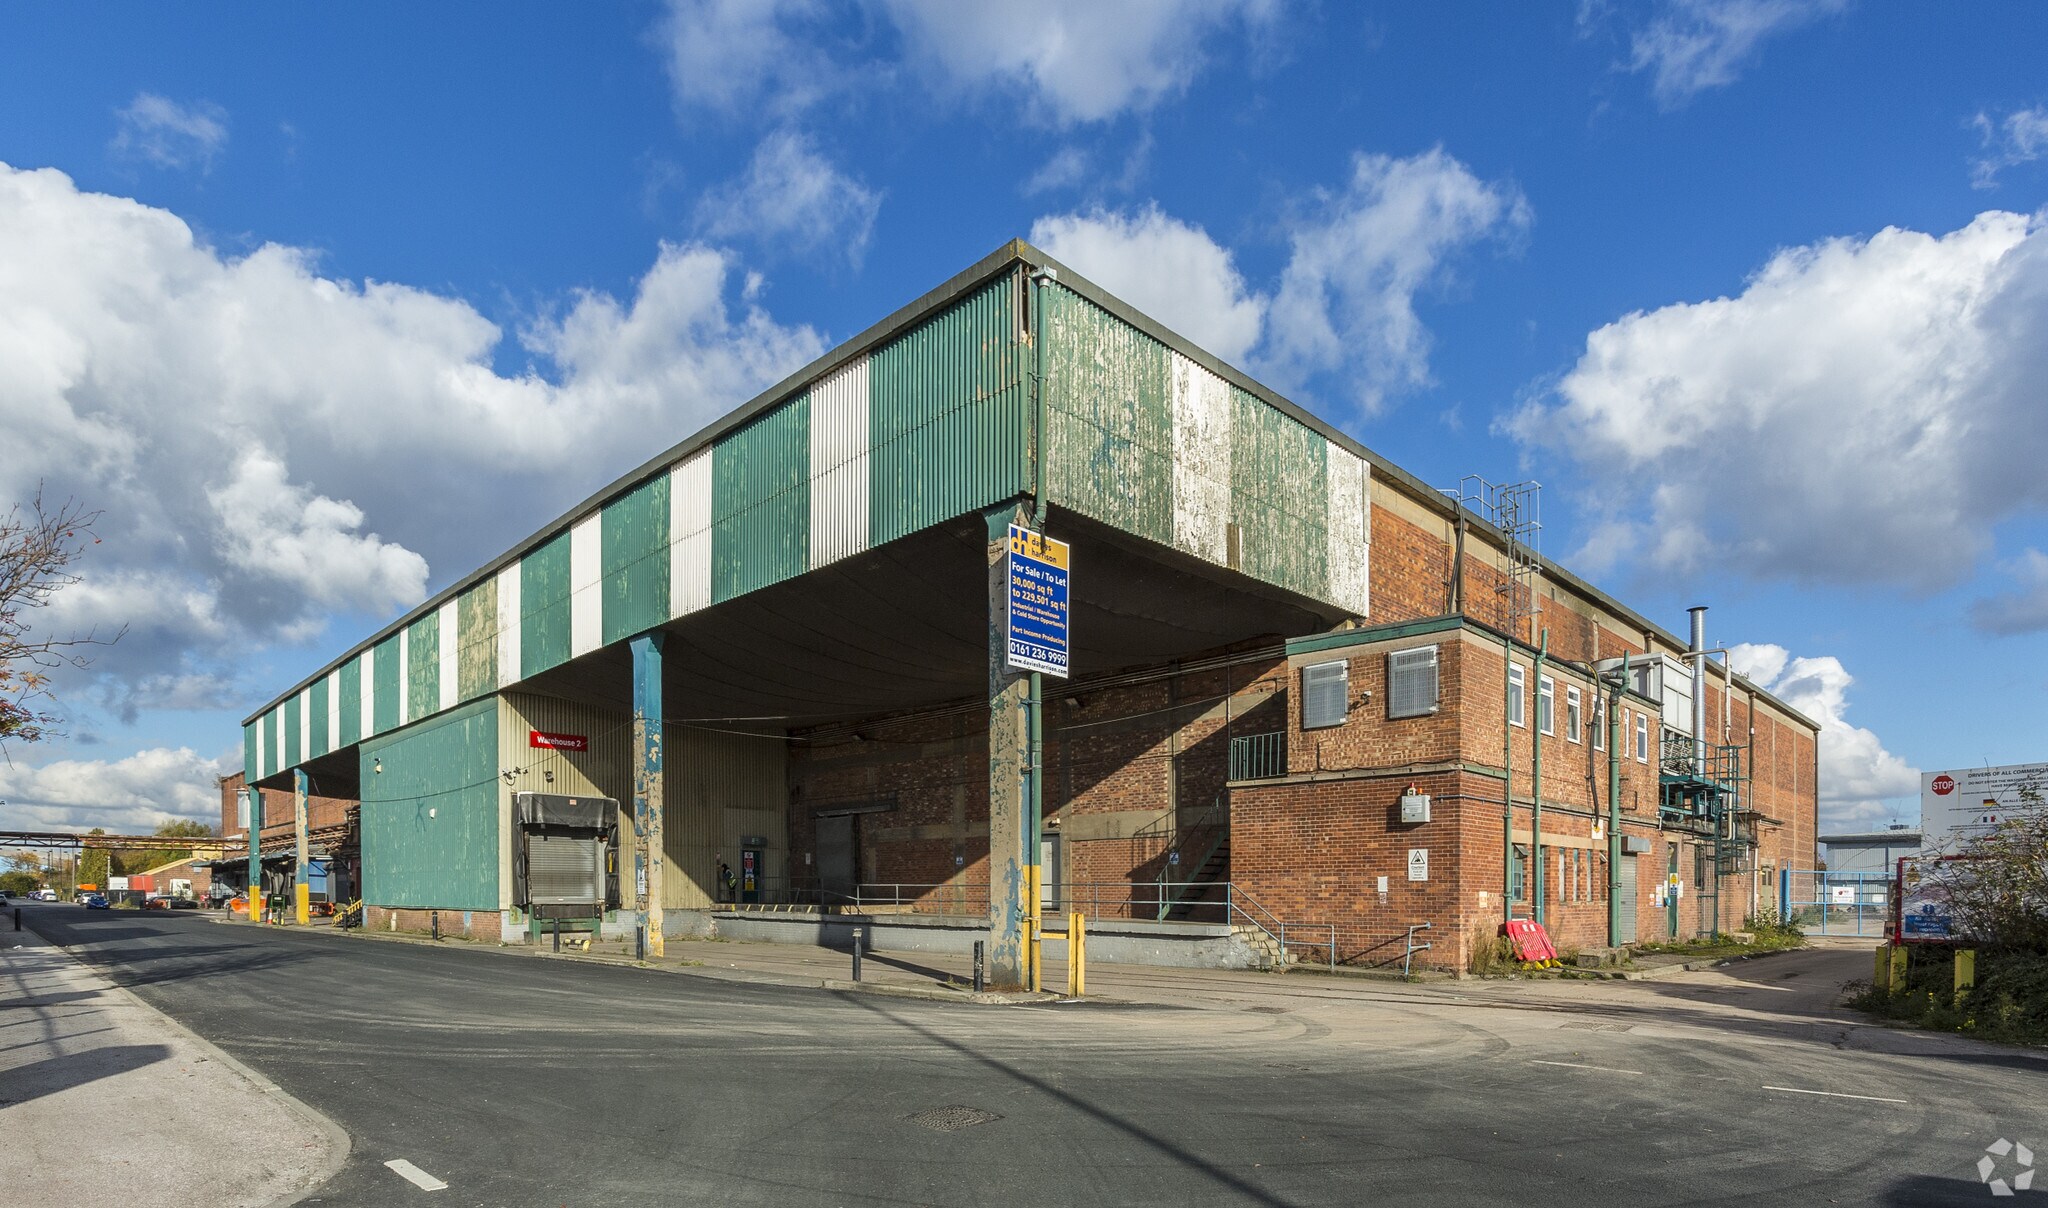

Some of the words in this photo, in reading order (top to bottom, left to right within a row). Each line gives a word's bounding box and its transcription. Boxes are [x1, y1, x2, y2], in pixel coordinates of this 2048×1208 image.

[1032, 538, 1052, 552] daes
[1012, 561, 1024, 573] For
[1025, 566, 1040, 578] Sale
[1041, 571, 1045, 580] /
[1045, 572, 1054, 582] To
[1055, 576, 1067, 587] Let
[1012, 576, 1036, 590] 30,000
[1037, 585, 1046, 596] sq
[1046, 586, 1054, 596] ft
[1012, 588, 1020, 598] to
[1022, 590, 1048, 606] 229,501
[1050, 600, 1058, 610] sq
[1060, 602, 1066, 611] ft
[1012, 602, 1034, 612] Industrial
[1036, 608, 1060, 620] Warehouse
[1040, 617, 1065, 630] Opportunity
[1012, 626, 1022, 634] Part
[1024, 628, 1041, 638] Income
[1042, 634, 1066, 646] Producing
[1010, 642, 1030, 656] 0161
[1032, 648, 1046, 660] 236
[1048, 652, 1066, 664] 9999
[1010, 658, 1067, 674] www.daviesharrison.com
[536, 736, 576, 746] Warehouse
[1932, 782, 1954, 790] STOP
